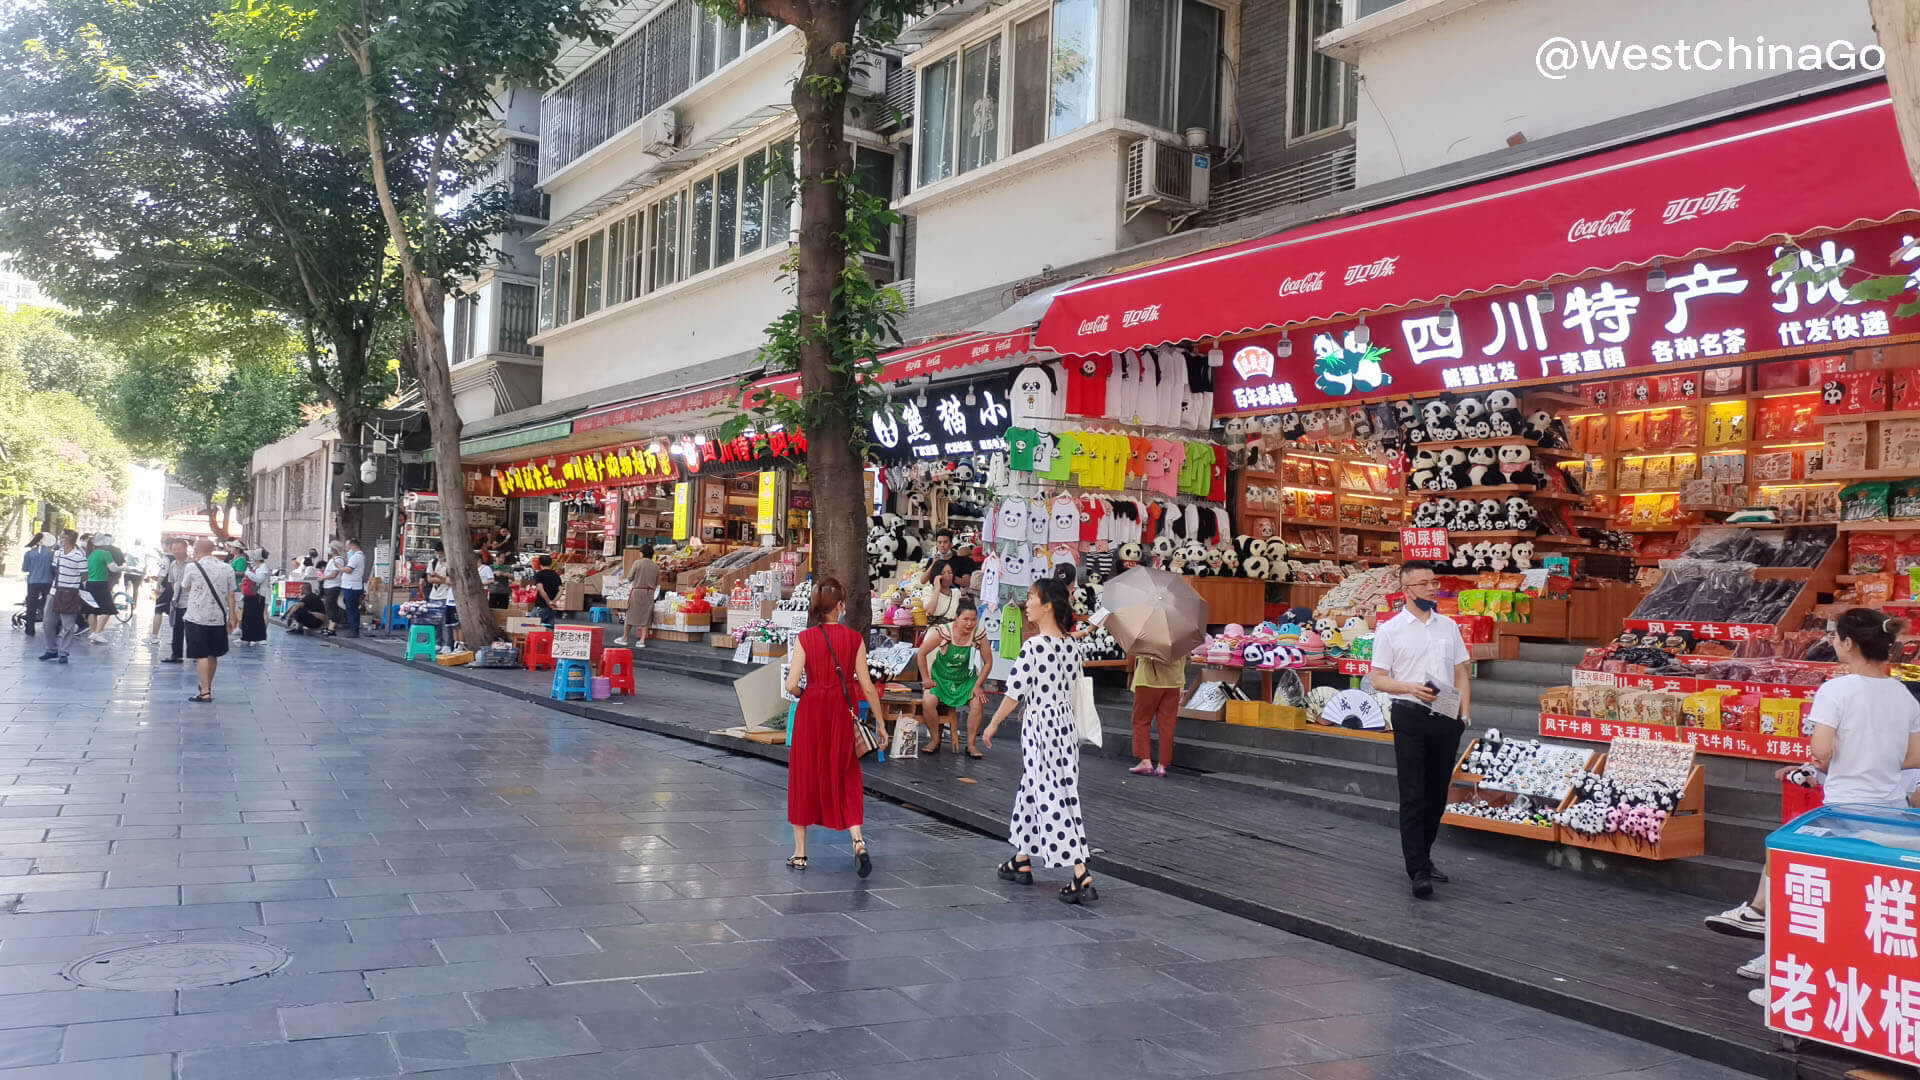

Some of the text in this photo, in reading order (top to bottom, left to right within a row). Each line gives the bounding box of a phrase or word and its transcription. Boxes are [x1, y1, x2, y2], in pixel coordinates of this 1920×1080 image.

[1662, 184, 1746, 224] 可口可乐
[1344, 256, 1400, 285] 可口可乐
[1122, 304, 1162, 327] 可口可乐
[1778, 310, 1890, 346] 代发快递
[1650, 327, 1746, 363] 各种名茶
[1540, 346, 1626, 378] 厂家直销
[1345, 660, 1369, 673] 牛肉
[1545, 718, 1592, 734] 风干牛肉
[1687, 732, 1733, 750] 张飞牛肉
[1785, 862, 1918, 958] 雪糕
[1770, 953, 1920, 1057] 老冰棍
